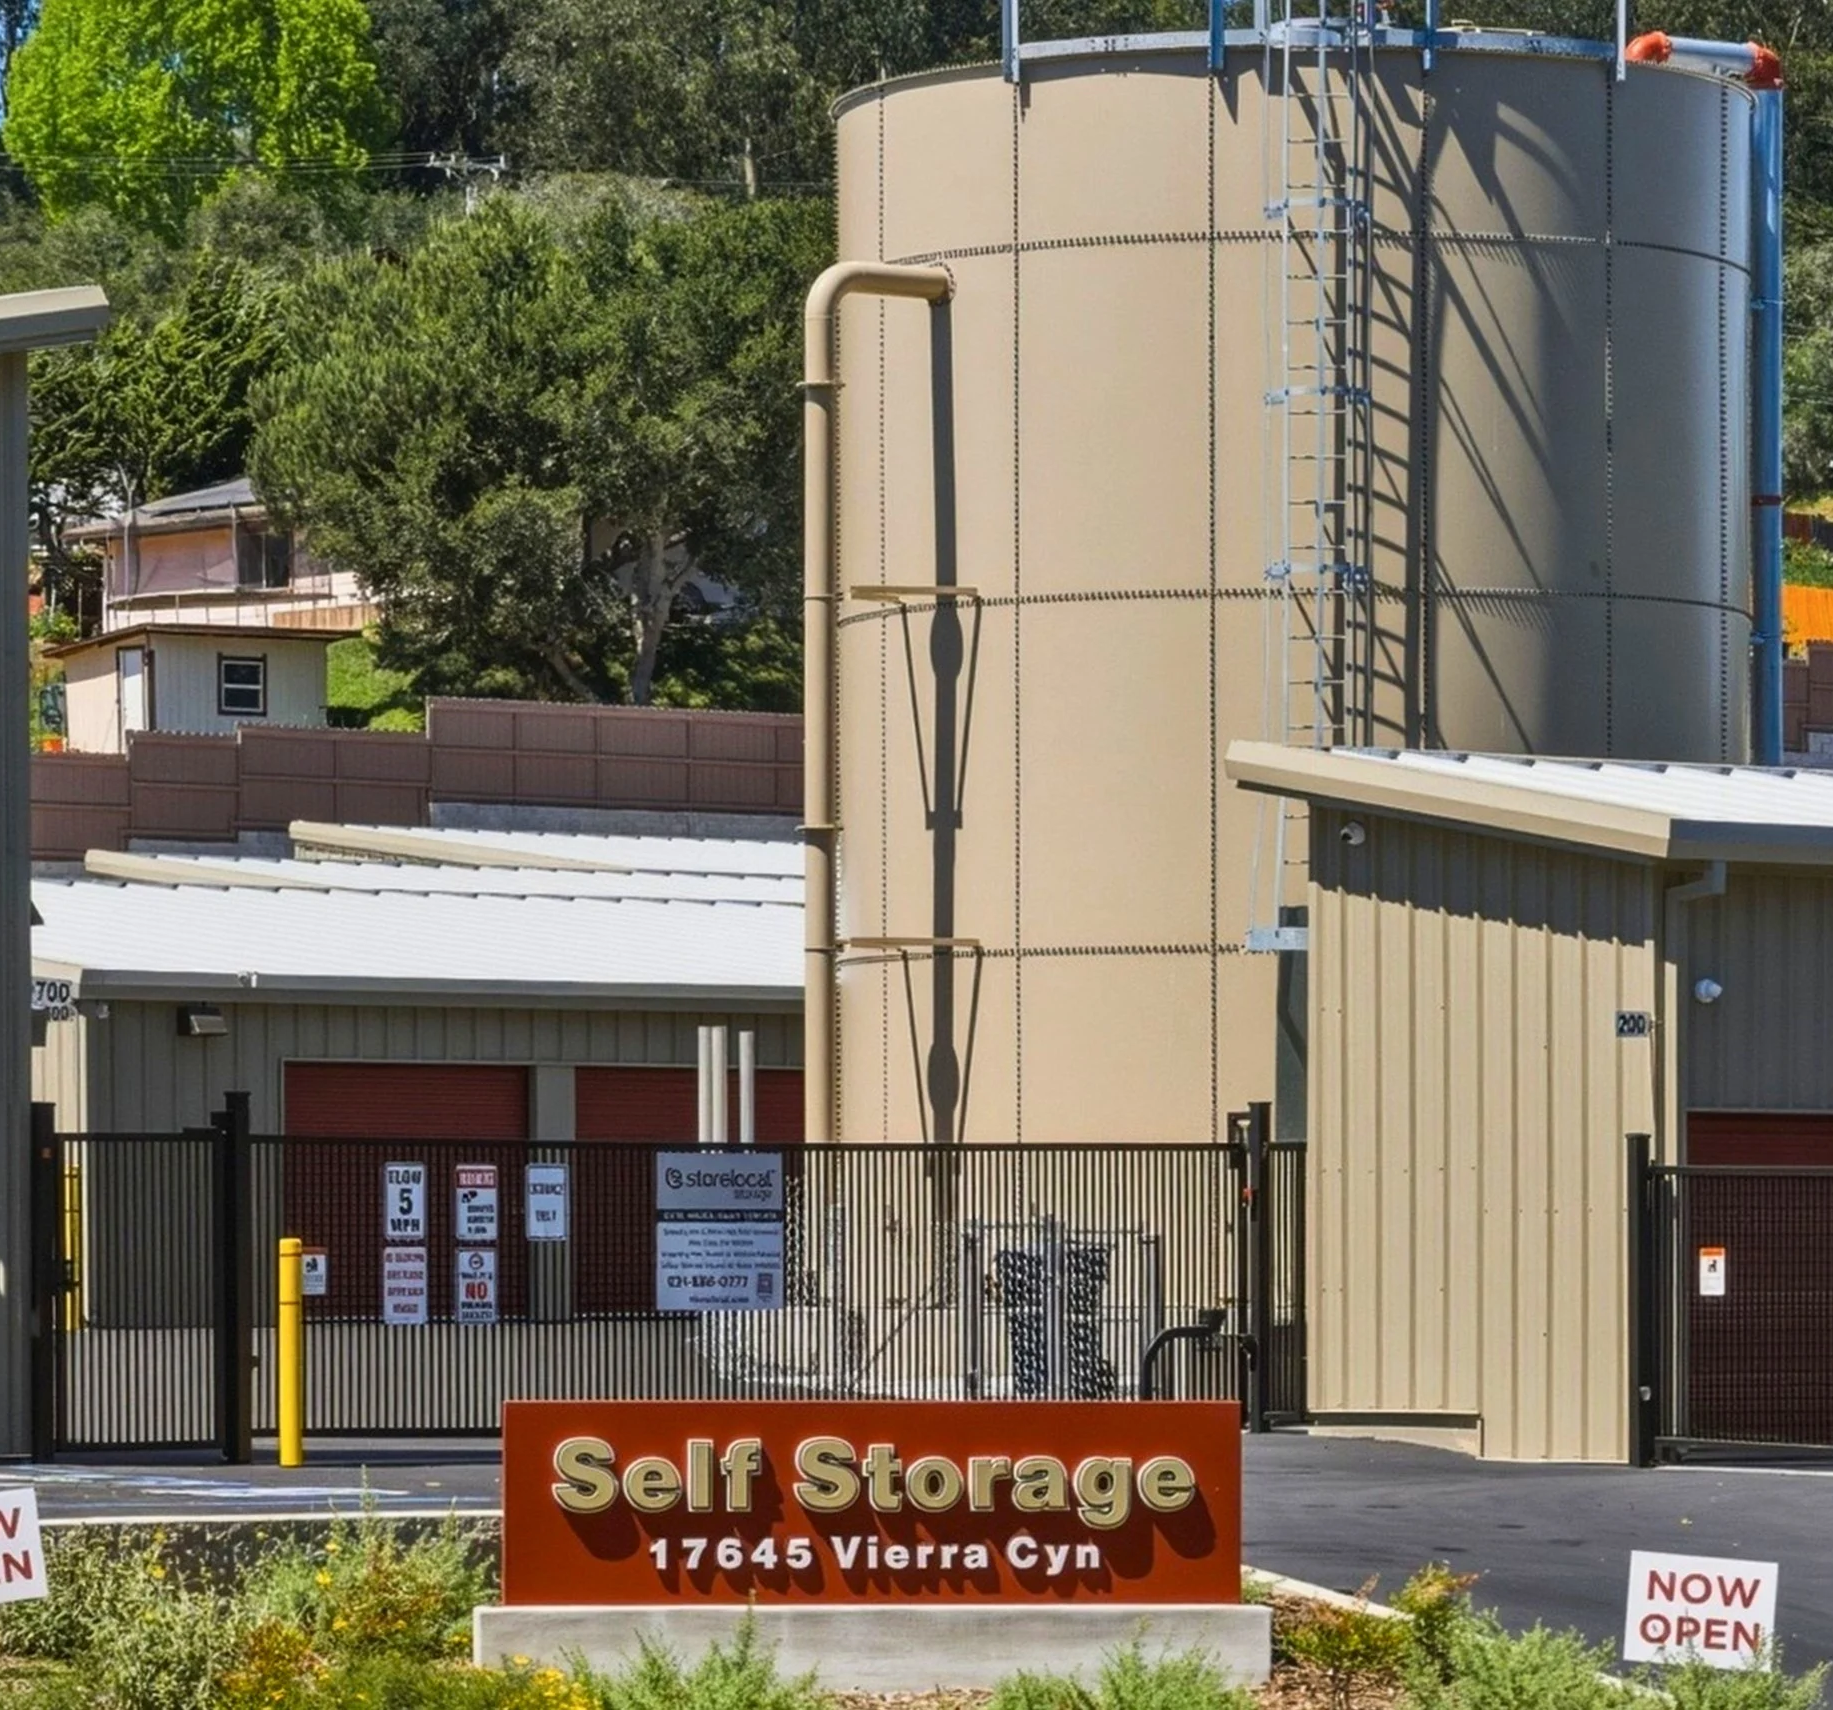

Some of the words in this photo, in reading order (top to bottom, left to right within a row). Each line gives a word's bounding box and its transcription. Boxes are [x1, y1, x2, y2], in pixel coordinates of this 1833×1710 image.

[35, 980, 70, 1003] 700
[1618, 1013, 1646, 1034] 200
[398, 1188, 414, 1215] 5
[465, 1281, 488, 1300] NO
[551, 1436, 763, 1514] Self
[792, 1435, 1197, 1531] Storage
[648, 1536, 814, 1570] 17645
[830, 1535, 989, 1570] Vierra
[1006, 1535, 1102, 1576] Cyn
[1646, 1570, 1762, 1610] NOW
[1639, 1613, 1761, 1655] OPEN
